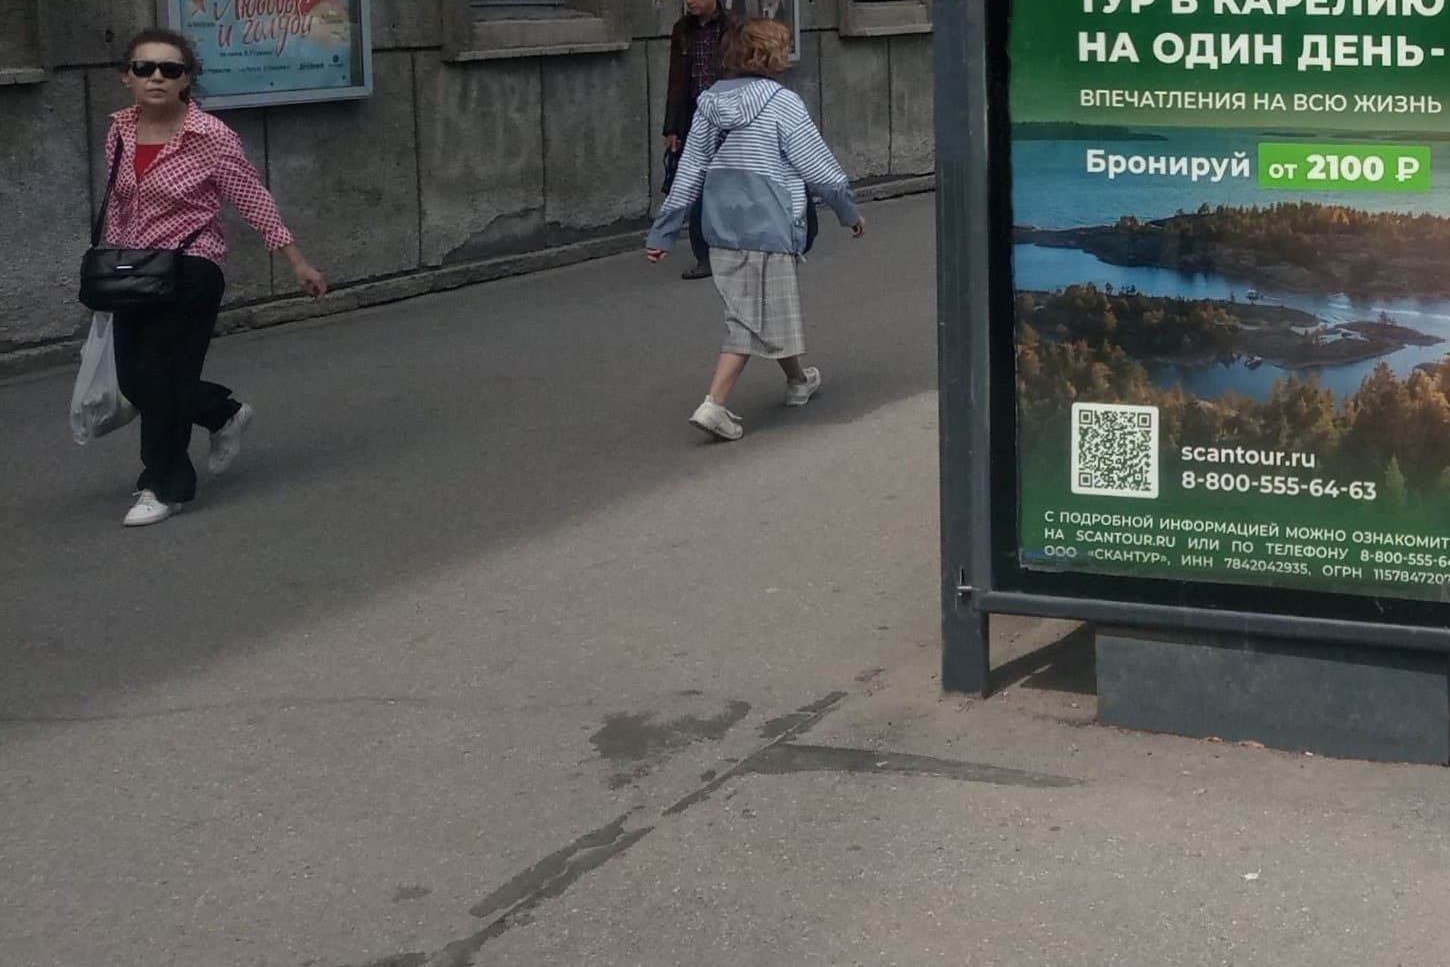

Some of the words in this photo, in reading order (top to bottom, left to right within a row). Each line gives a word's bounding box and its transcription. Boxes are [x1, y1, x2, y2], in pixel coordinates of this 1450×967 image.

[1078, 31, 1140, 63] НА
[1152, 32, 1282, 70] ОДИН
[1080, 89, 1246, 110] ВПЕЧАТЛЕНИЯ
[1253, 92, 1287, 111] НА
[1293, 93, 1348, 112] ВСЮ
[1353, 94, 1442, 114] ЖИЗНЬ
[1086, 149, 1250, 183] Бронируй
[1268, 163, 1298, 180] от
[1306, 154, 1385, 182] 2100
[1395, 156, 1420, 182] ₽
[1181, 446, 1315, 468] scantour.ru
[1181, 470, 1377, 501] 8-800-555-64-63
[1044, 510, 1055, 523] С
[1059, 511, 1154, 529] ПОДРОБНОЙ
[1159, 517, 1280, 538] ИНФОРМАЦИЕЙ
[1285, 526, 1347, 542] МОЖНО
[1044, 527, 1065, 540] НА
[1076, 529, 1176, 548] SCANTOUR.RU
[1187, 537, 1220, 551] ИЛИ
[1231, 540, 1254, 554] ПО
[1265, 542, 1349, 560] ТЕЛЕФОНУ
[1044, 544, 1078, 558] ООО
[1181, 554, 1214, 568] ИНН
[1223, 557, 1312, 576] 7842042935,
[1322, 564, 1362, 579] ОГРН
